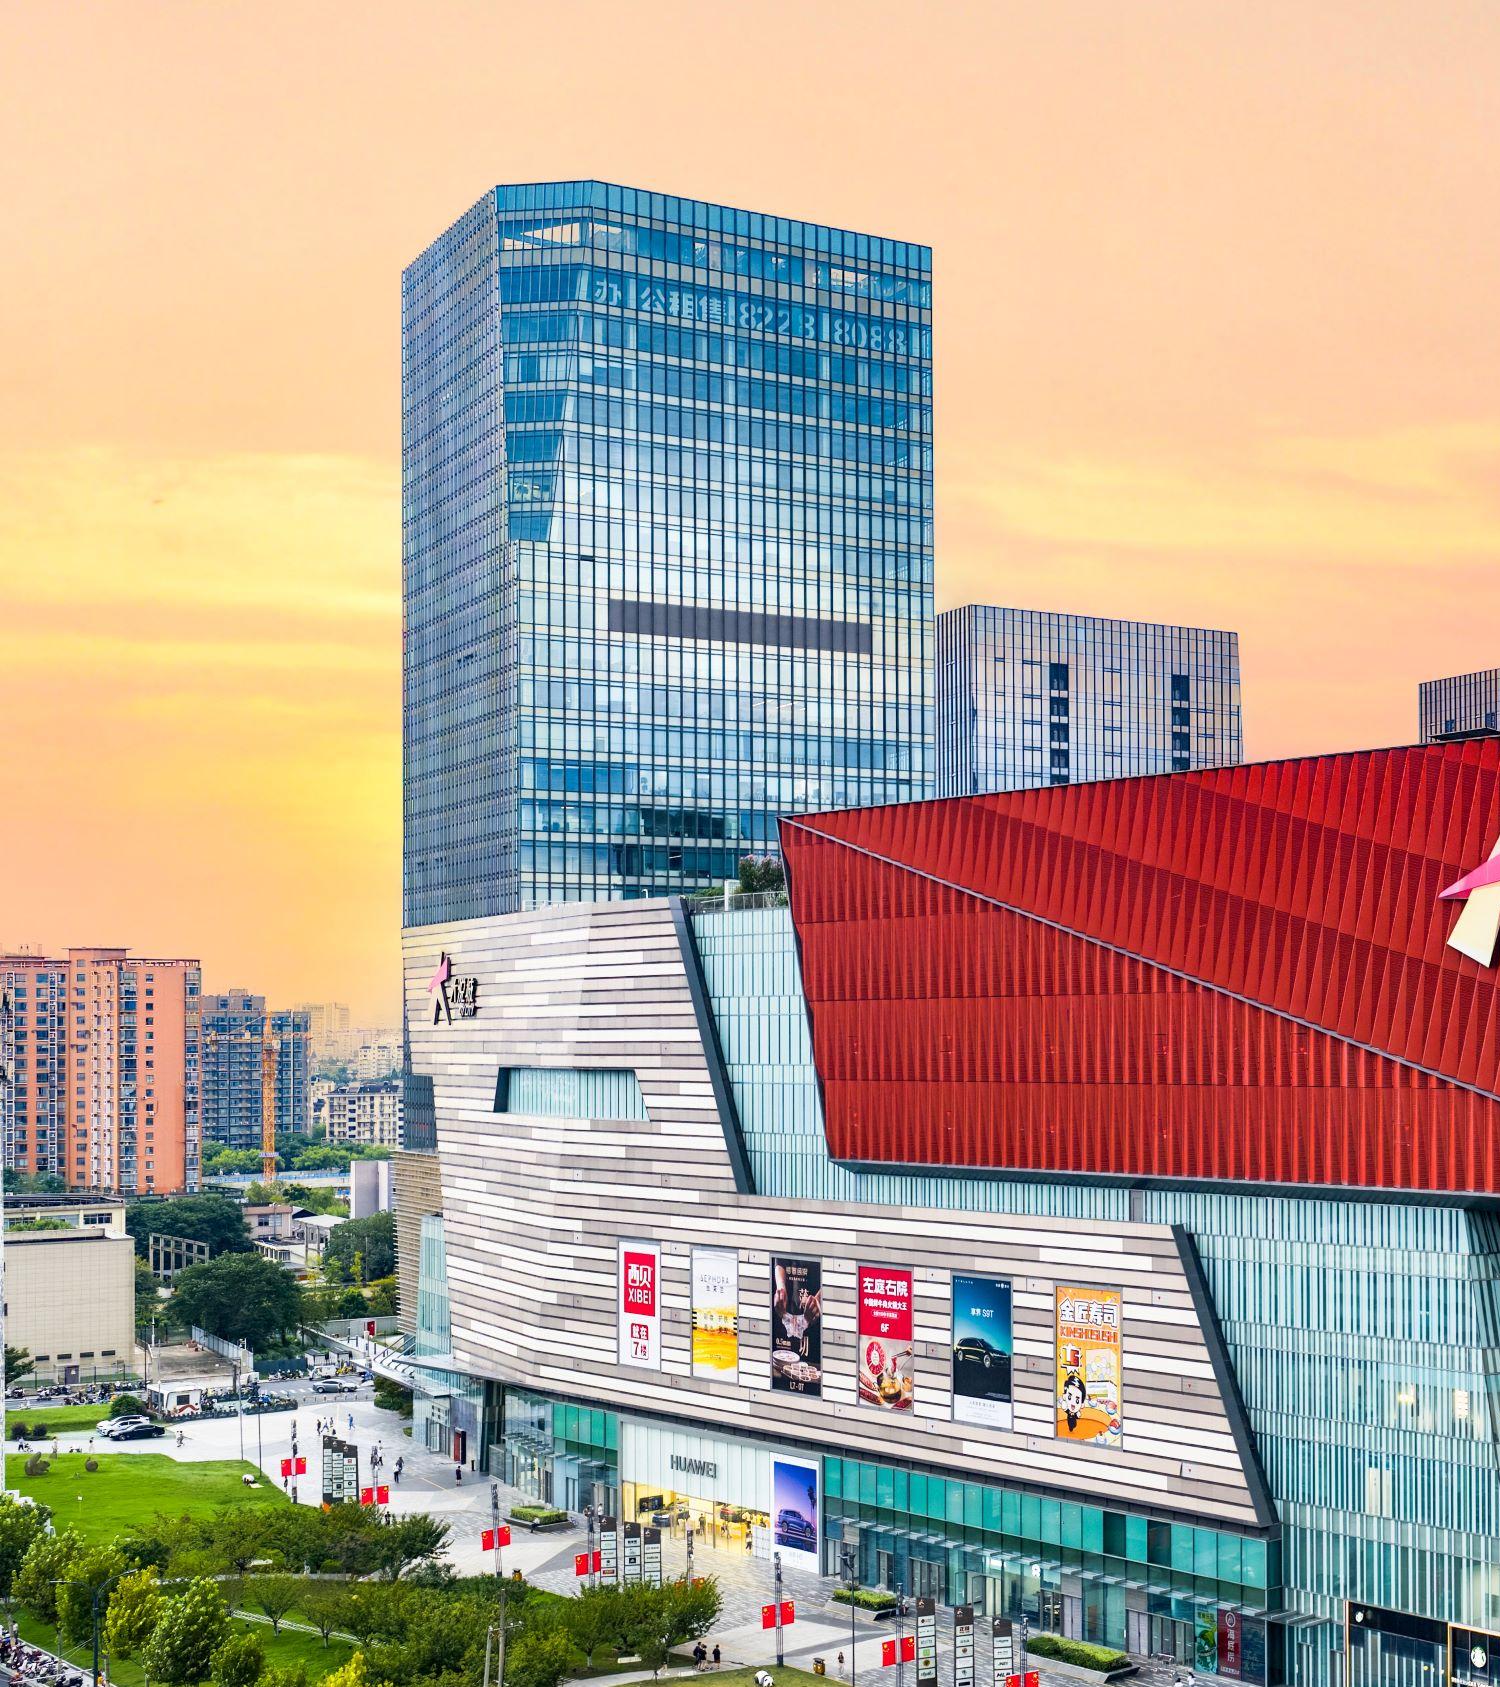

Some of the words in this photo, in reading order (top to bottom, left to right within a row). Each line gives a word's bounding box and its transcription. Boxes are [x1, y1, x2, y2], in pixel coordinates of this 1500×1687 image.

[628, 1288, 652, 1305] XIBEI
[1059, 1298, 1117, 1328] 金匠寿司
[670, 1454, 717, 1479] HUAWEI
